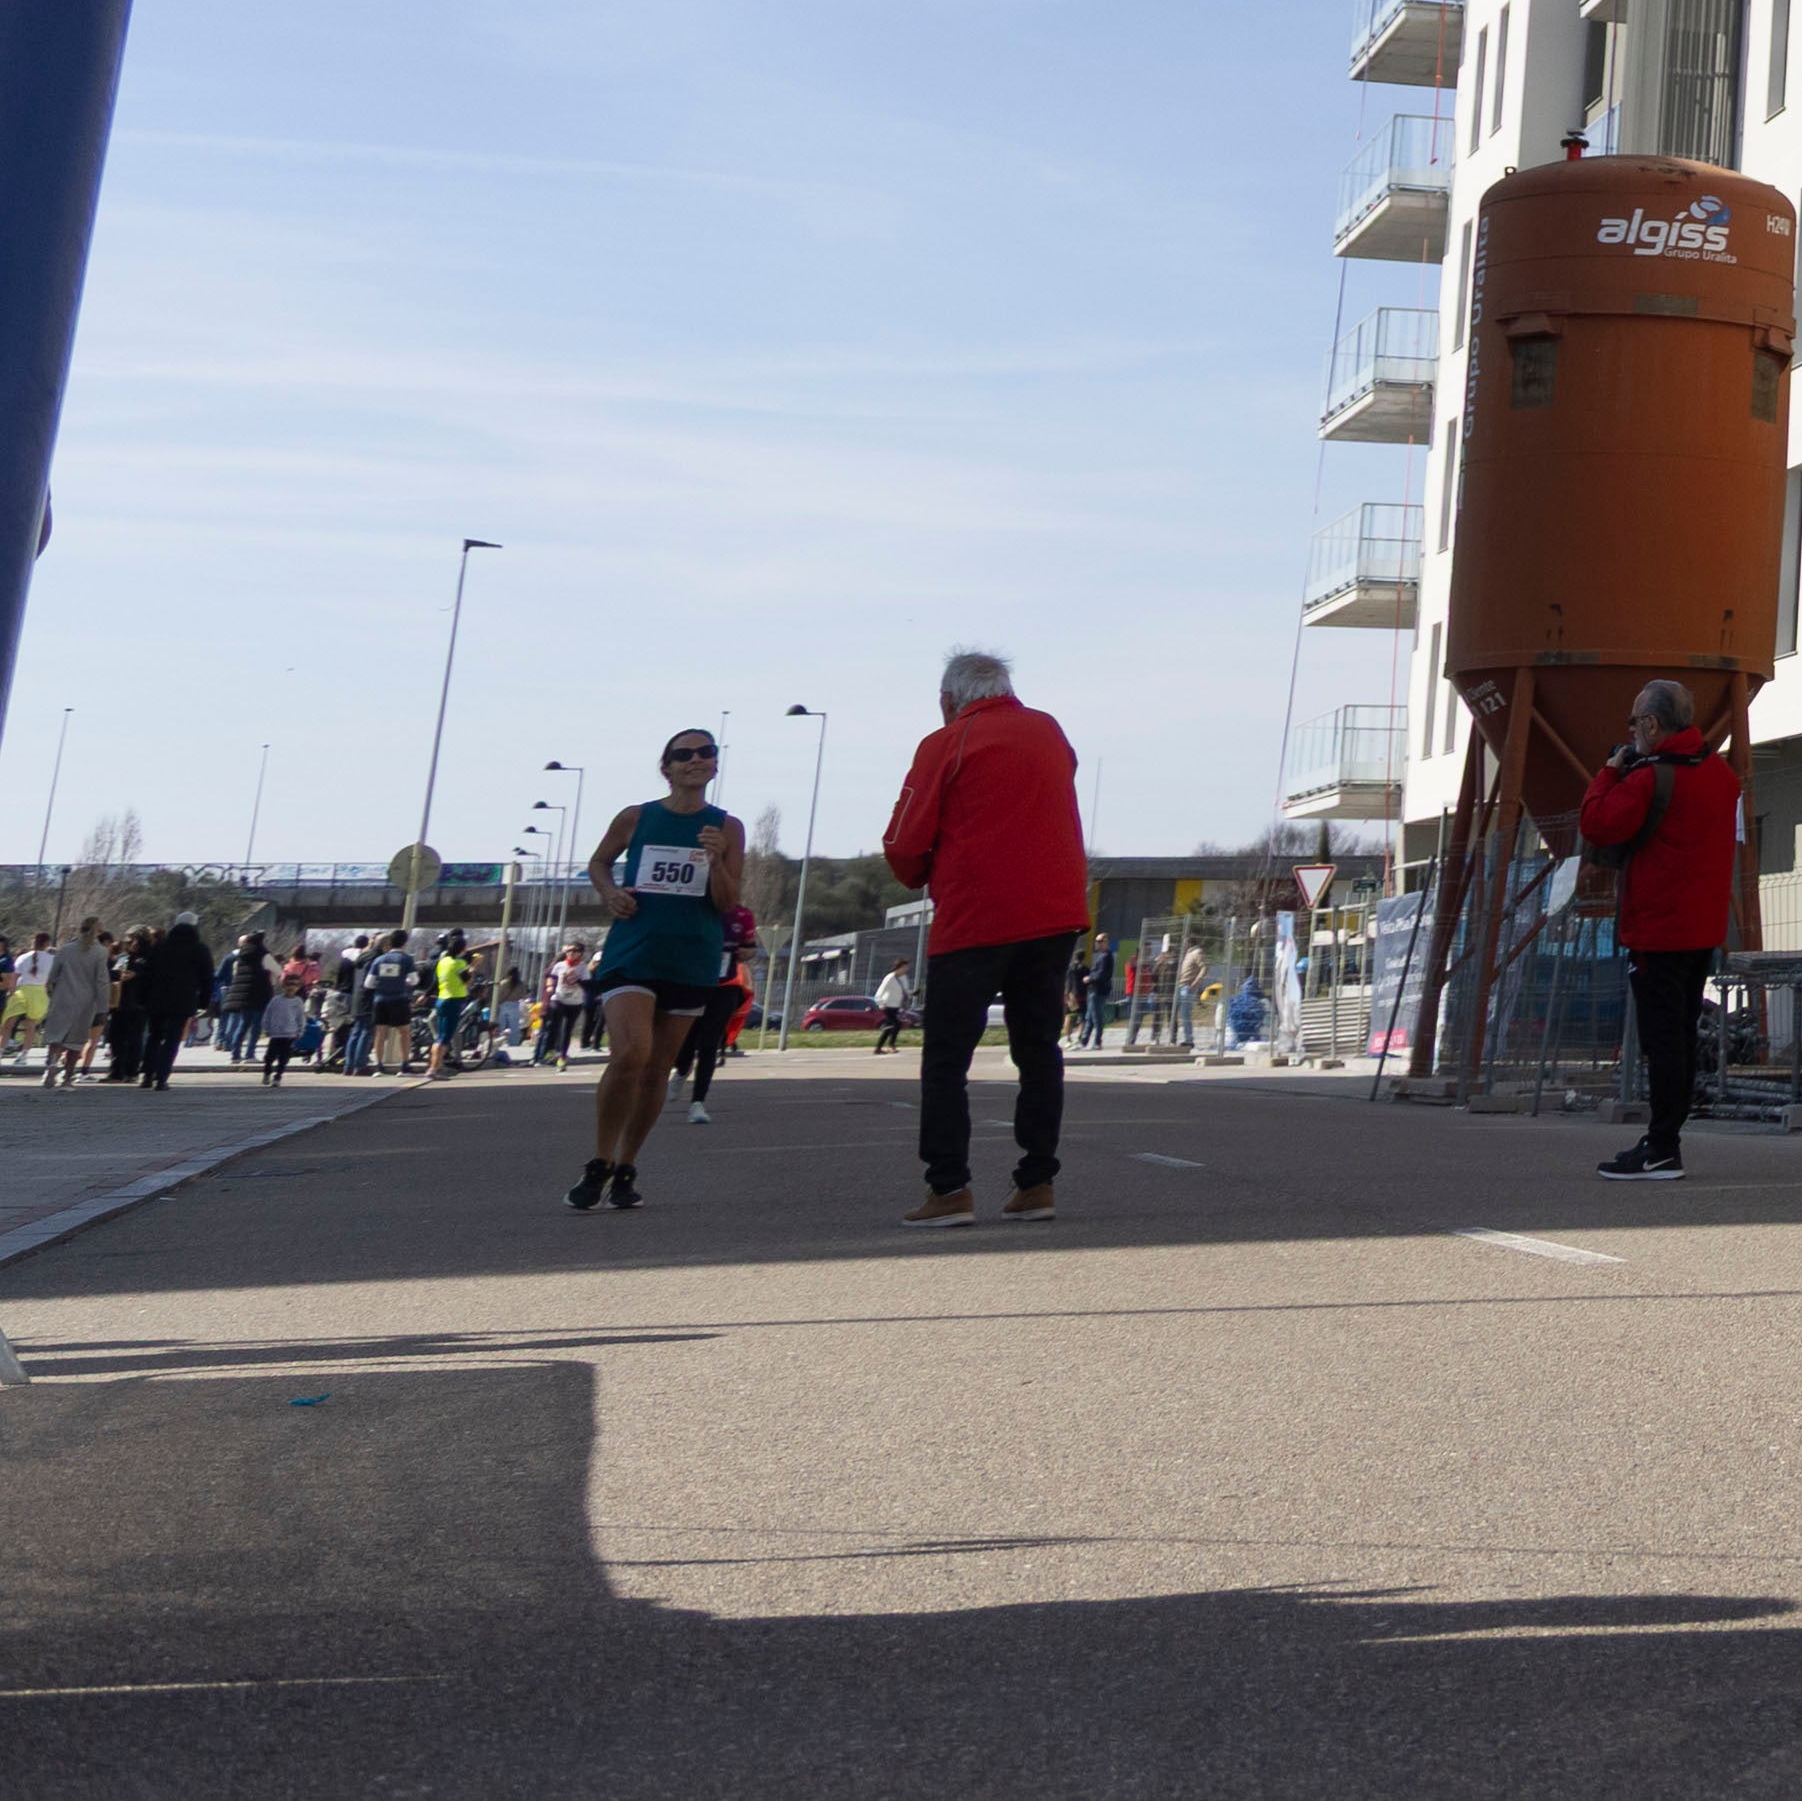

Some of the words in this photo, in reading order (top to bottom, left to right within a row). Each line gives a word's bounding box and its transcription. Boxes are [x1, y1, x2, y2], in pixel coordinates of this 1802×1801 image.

[1663, 246, 1700, 260] Grupo
[1702, 249, 1738, 265] Uralita
[652, 861, 695, 883] 550
